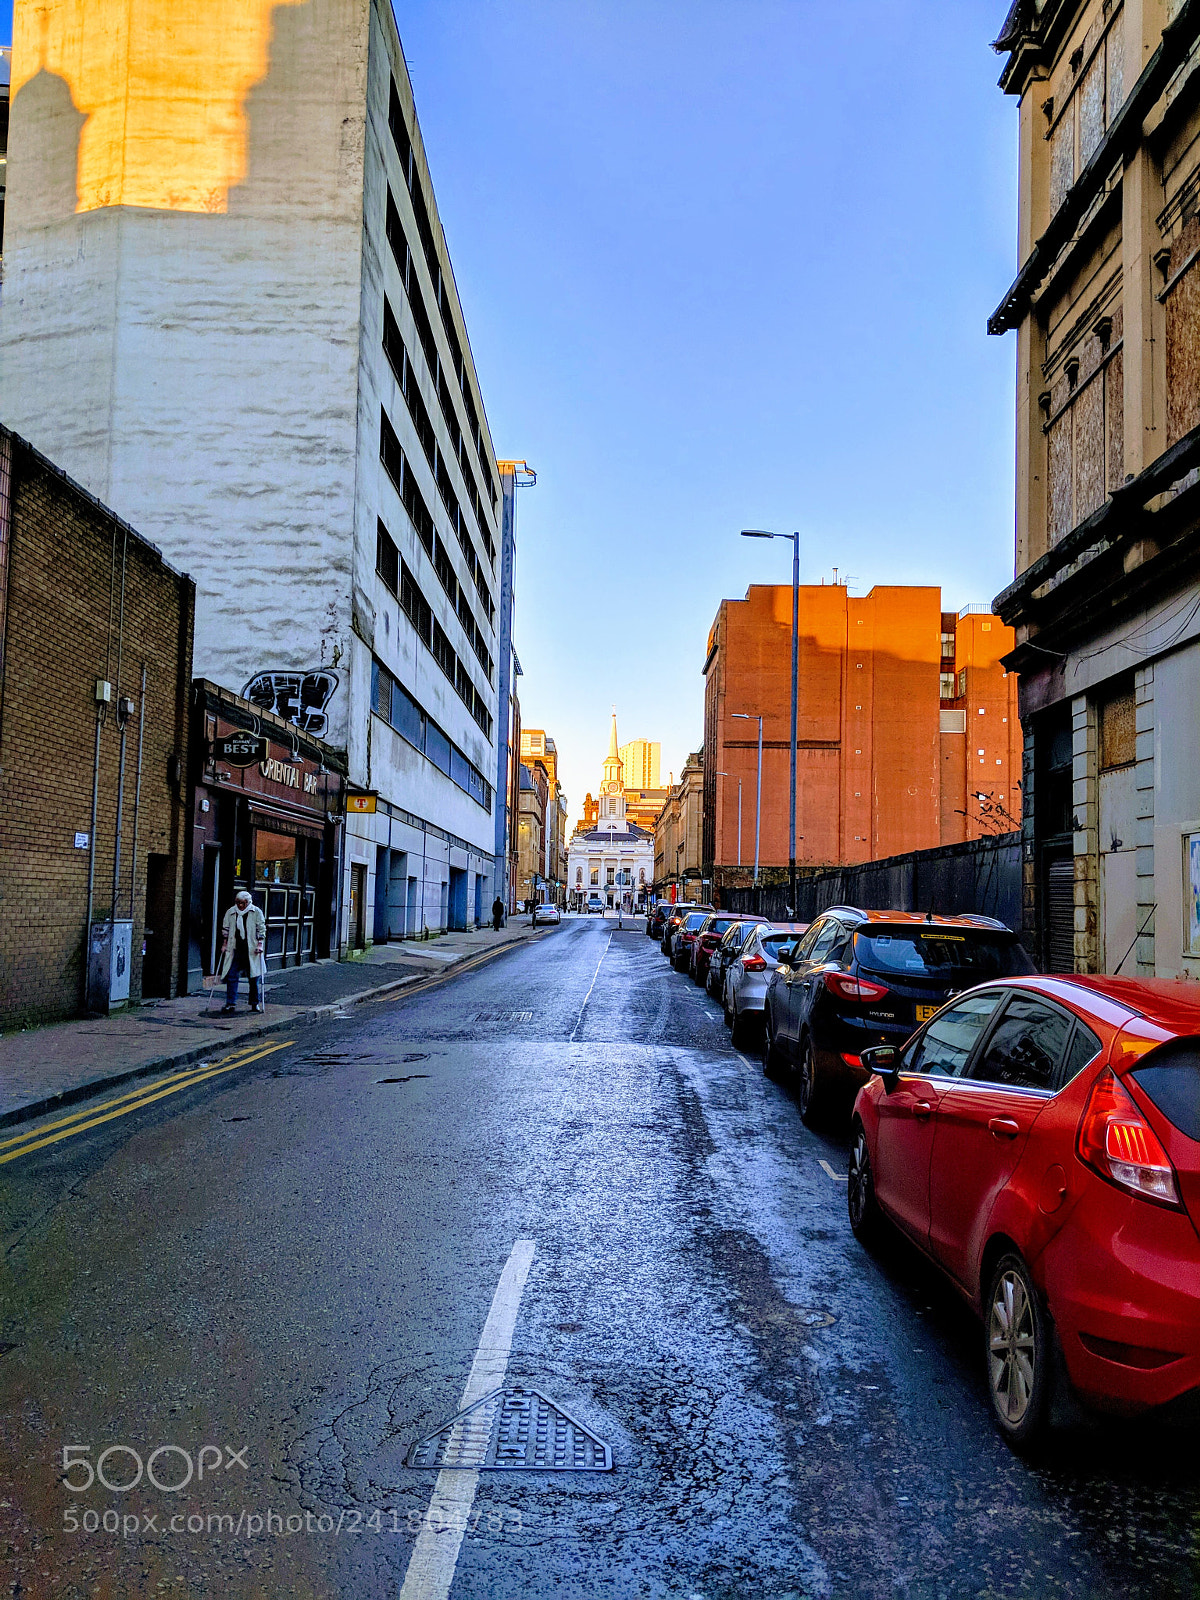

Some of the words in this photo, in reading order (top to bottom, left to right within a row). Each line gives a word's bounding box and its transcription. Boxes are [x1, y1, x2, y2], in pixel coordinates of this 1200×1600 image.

[223, 743, 259, 754] BEST
[259, 757, 300, 789] ORIENTAL
[303, 772, 318, 796] BAR
[356, 798, 366, 809] T
